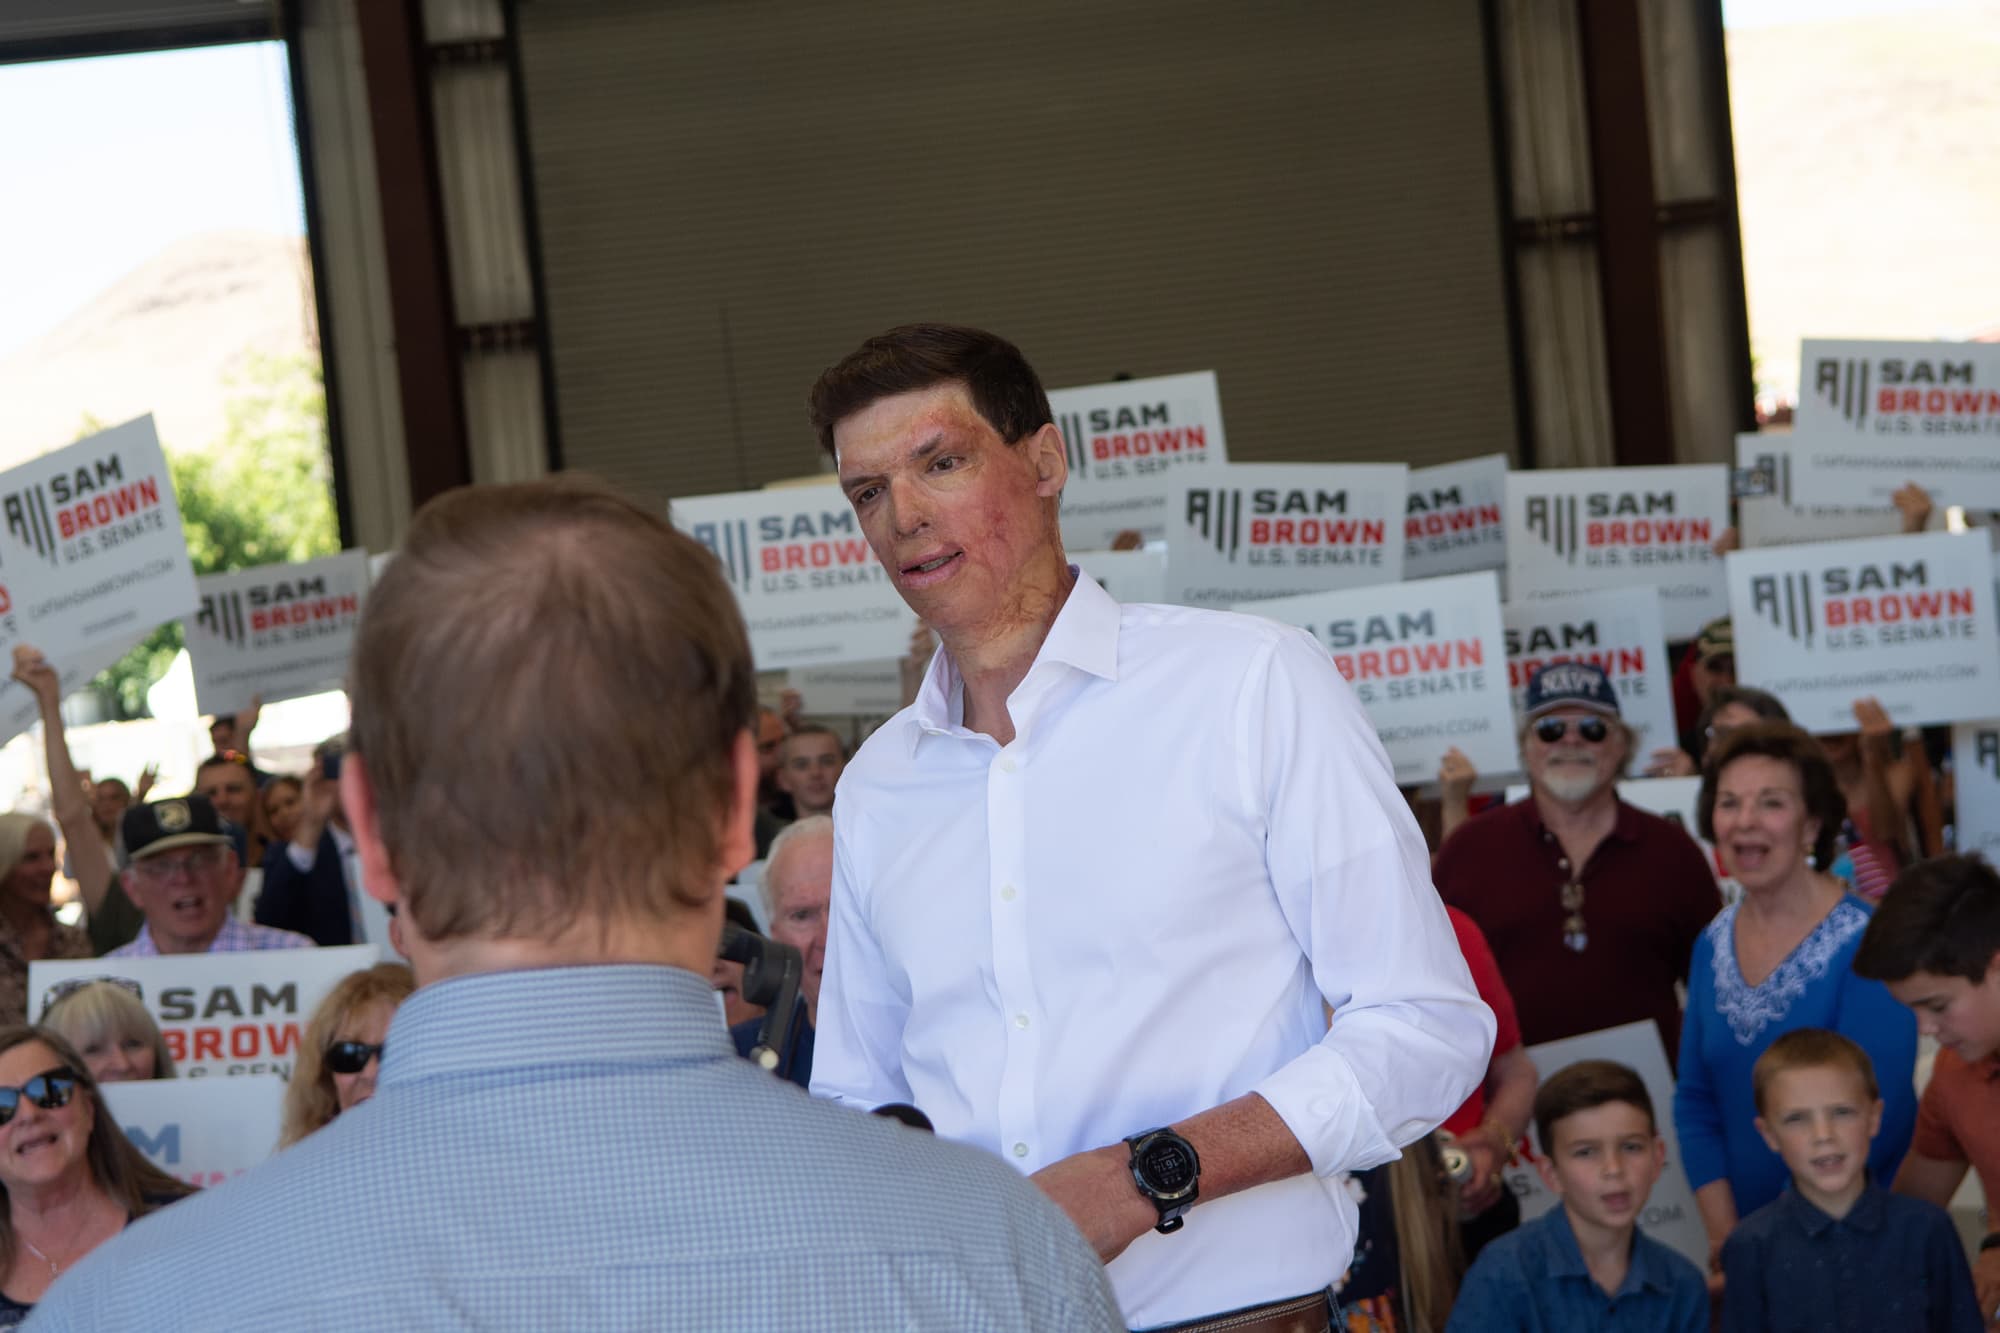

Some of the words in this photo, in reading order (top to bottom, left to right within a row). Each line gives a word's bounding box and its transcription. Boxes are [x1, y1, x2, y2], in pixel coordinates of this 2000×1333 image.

[1879, 359, 1973, 384] SAM
[1089, 402, 1169, 432] SAM
[1877, 387, 2000, 416] BROWN
[1921, 416, 2000, 436] SENAT
[1092, 425, 1206, 461] BROWN
[51, 453, 123, 504] SAM
[56, 476, 160, 541] BROWN
[1252, 489, 1348, 514] SAM
[1405, 485, 1461, 514] AM
[1587, 491, 1676, 517] SAM
[759, 510, 853, 541] SAM
[1250, 519, 1385, 545] BROWN
[1404, 502, 1501, 540] ROWN
[1586, 518, 1711, 547] BROWN
[760, 539, 880, 573] BROW
[1248, 549, 1291, 566] U.S.
[1298, 548, 1382, 567] SENATE
[247, 575, 327, 606] SAM
[1823, 560, 1926, 595] SAM
[250, 592, 358, 632] BROWN
[1825, 586, 1974, 628] BROWN
[1328, 607, 1436, 649] SAM
[1504, 619, 1597, 656] SAM
[1826, 630, 1871, 649] U.S.
[1878, 618, 1977, 645] SENATE
[1332, 637, 1483, 683] BROWN
[1387, 669, 1487, 699] SENATE
[1540, 664, 1602, 698] NAVY
[159, 981, 297, 1021] SAM
[161, 1021, 308, 1063] BROW
